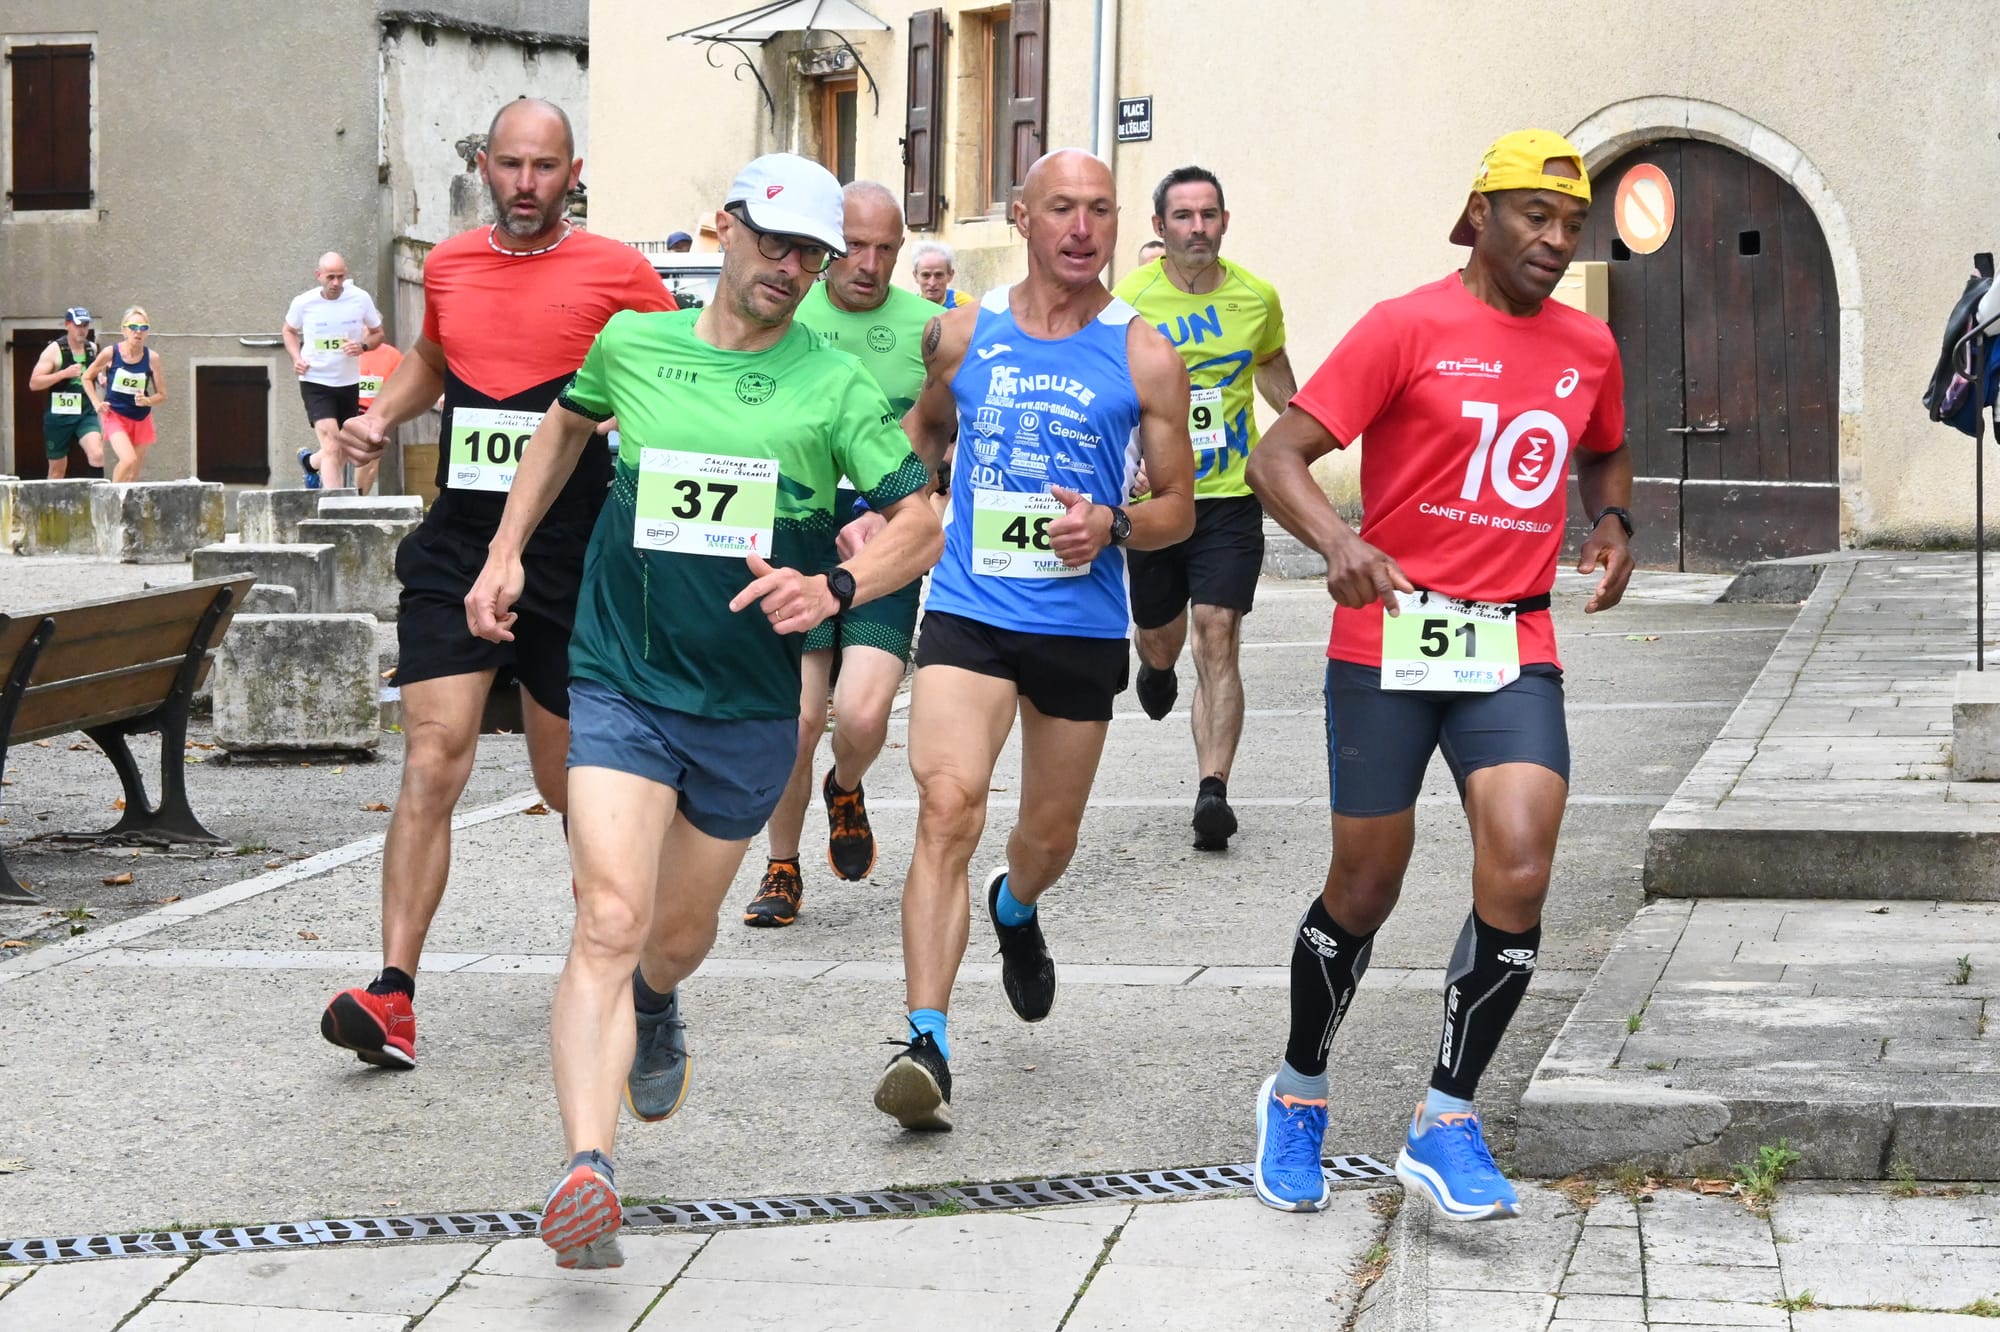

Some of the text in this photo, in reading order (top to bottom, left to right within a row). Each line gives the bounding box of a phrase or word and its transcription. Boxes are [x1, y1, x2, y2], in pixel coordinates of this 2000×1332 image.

[1123, 103, 1145, 117] PLACE
[1119, 124, 1125, 135] DE
[1157, 304, 1223, 347] UN
[323, 340, 340, 350] 15
[657, 366, 698, 384] GOBIK
[122, 378, 138, 388] 62
[360, 381, 375, 391] 26
[60, 398, 74, 408] 30
[1192, 406, 1211, 430] 9
[1460, 401, 1569, 509] 10
[1516, 436, 1548, 483] KM
[704, 457, 748, 470] Challenge
[699, 466, 771, 478] vallées cévenoles
[671, 480, 738, 522] 37
[1419, 502, 1553, 533] CANET EN ROUSSILLON
[646, 528, 675, 538] BFP
[704, 533, 746, 545] TUFF'S
[1002, 516, 1053, 550] 48
[707, 541, 749, 550] Aventure
[983, 557, 1008, 565] BFP
[1419, 619, 1477, 658] 51
[1395, 669, 1425, 678] BFP
[1453, 670, 1494, 680] TUFF'S
[1441, 984, 1462, 1069] BOOSTER
